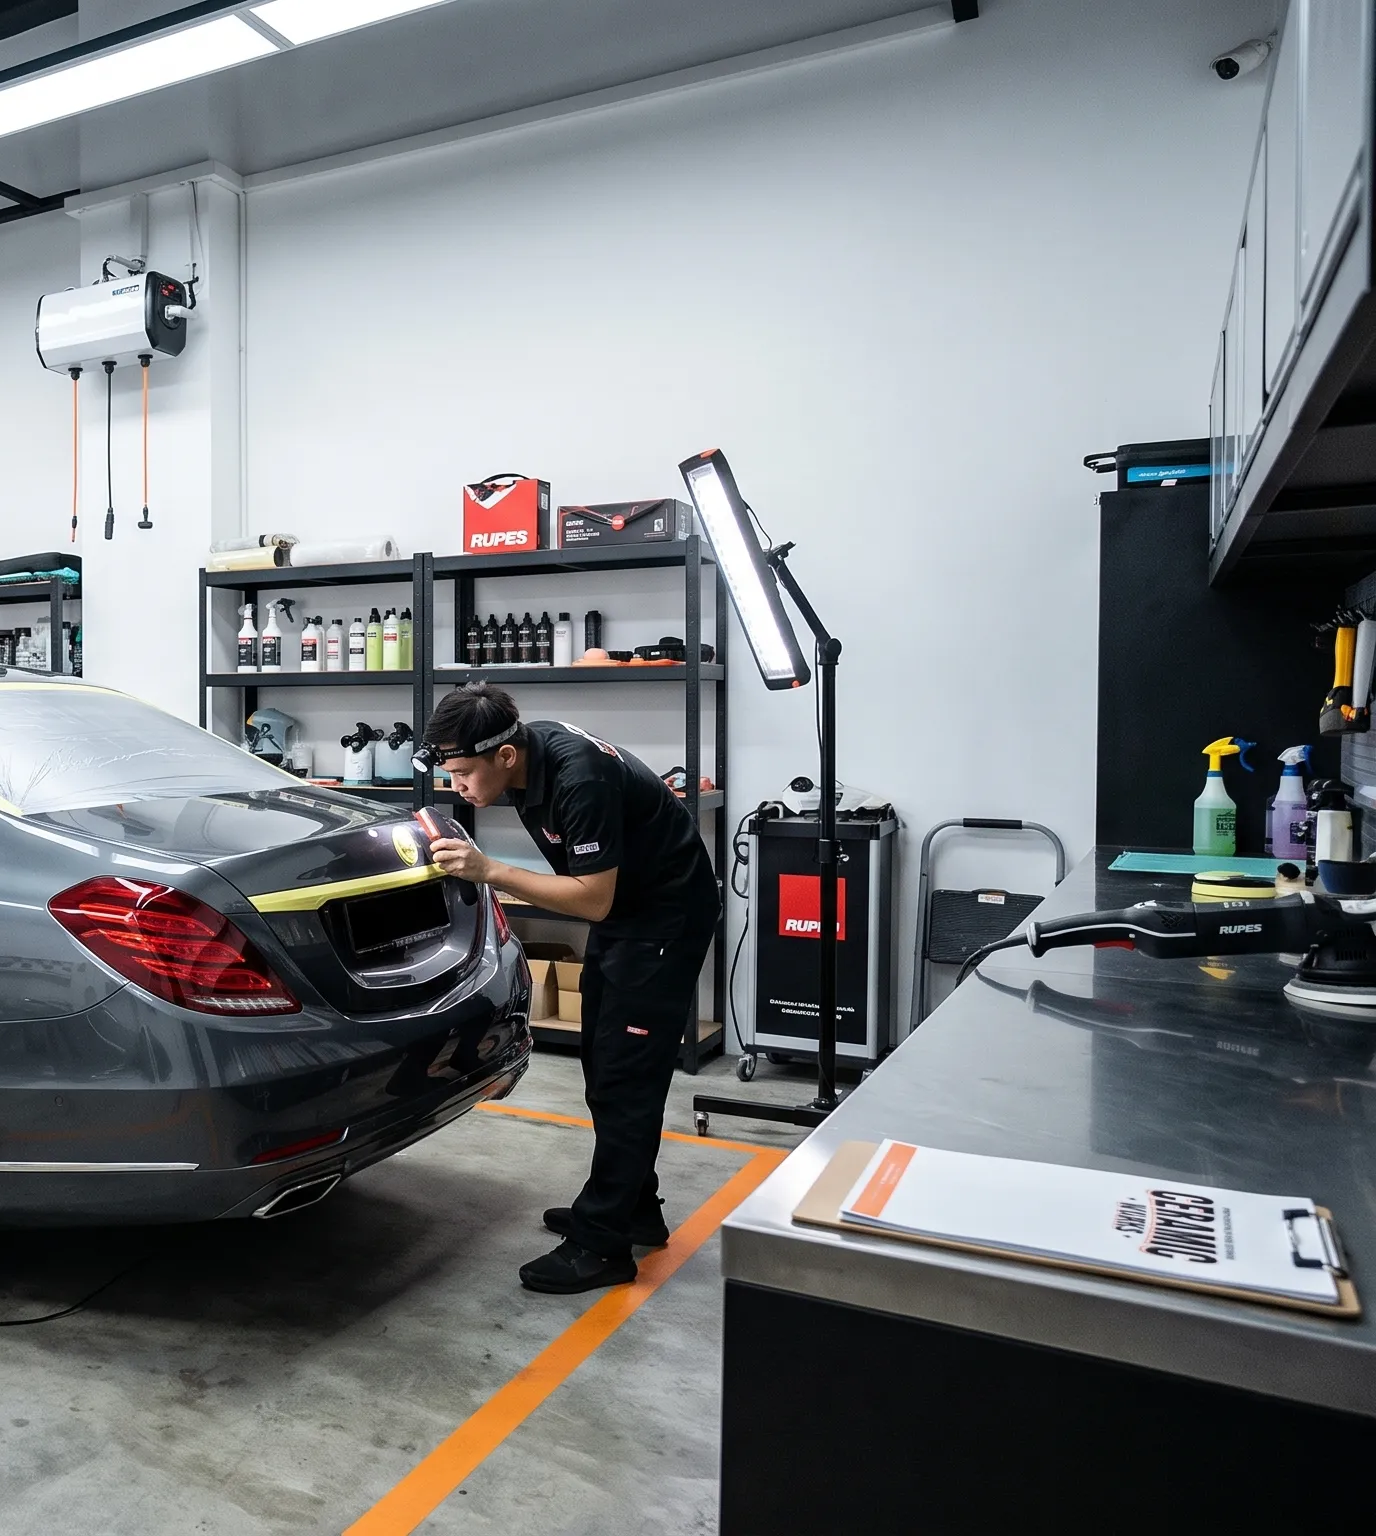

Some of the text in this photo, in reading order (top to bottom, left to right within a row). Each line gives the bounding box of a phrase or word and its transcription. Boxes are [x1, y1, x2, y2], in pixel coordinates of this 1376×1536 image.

[470, 530, 528, 549] RUPES
[785, 918, 840, 933] RUP
[1219, 923, 1263, 935] RUPES
[1145, 1190, 1218, 1264] CERAMIC
